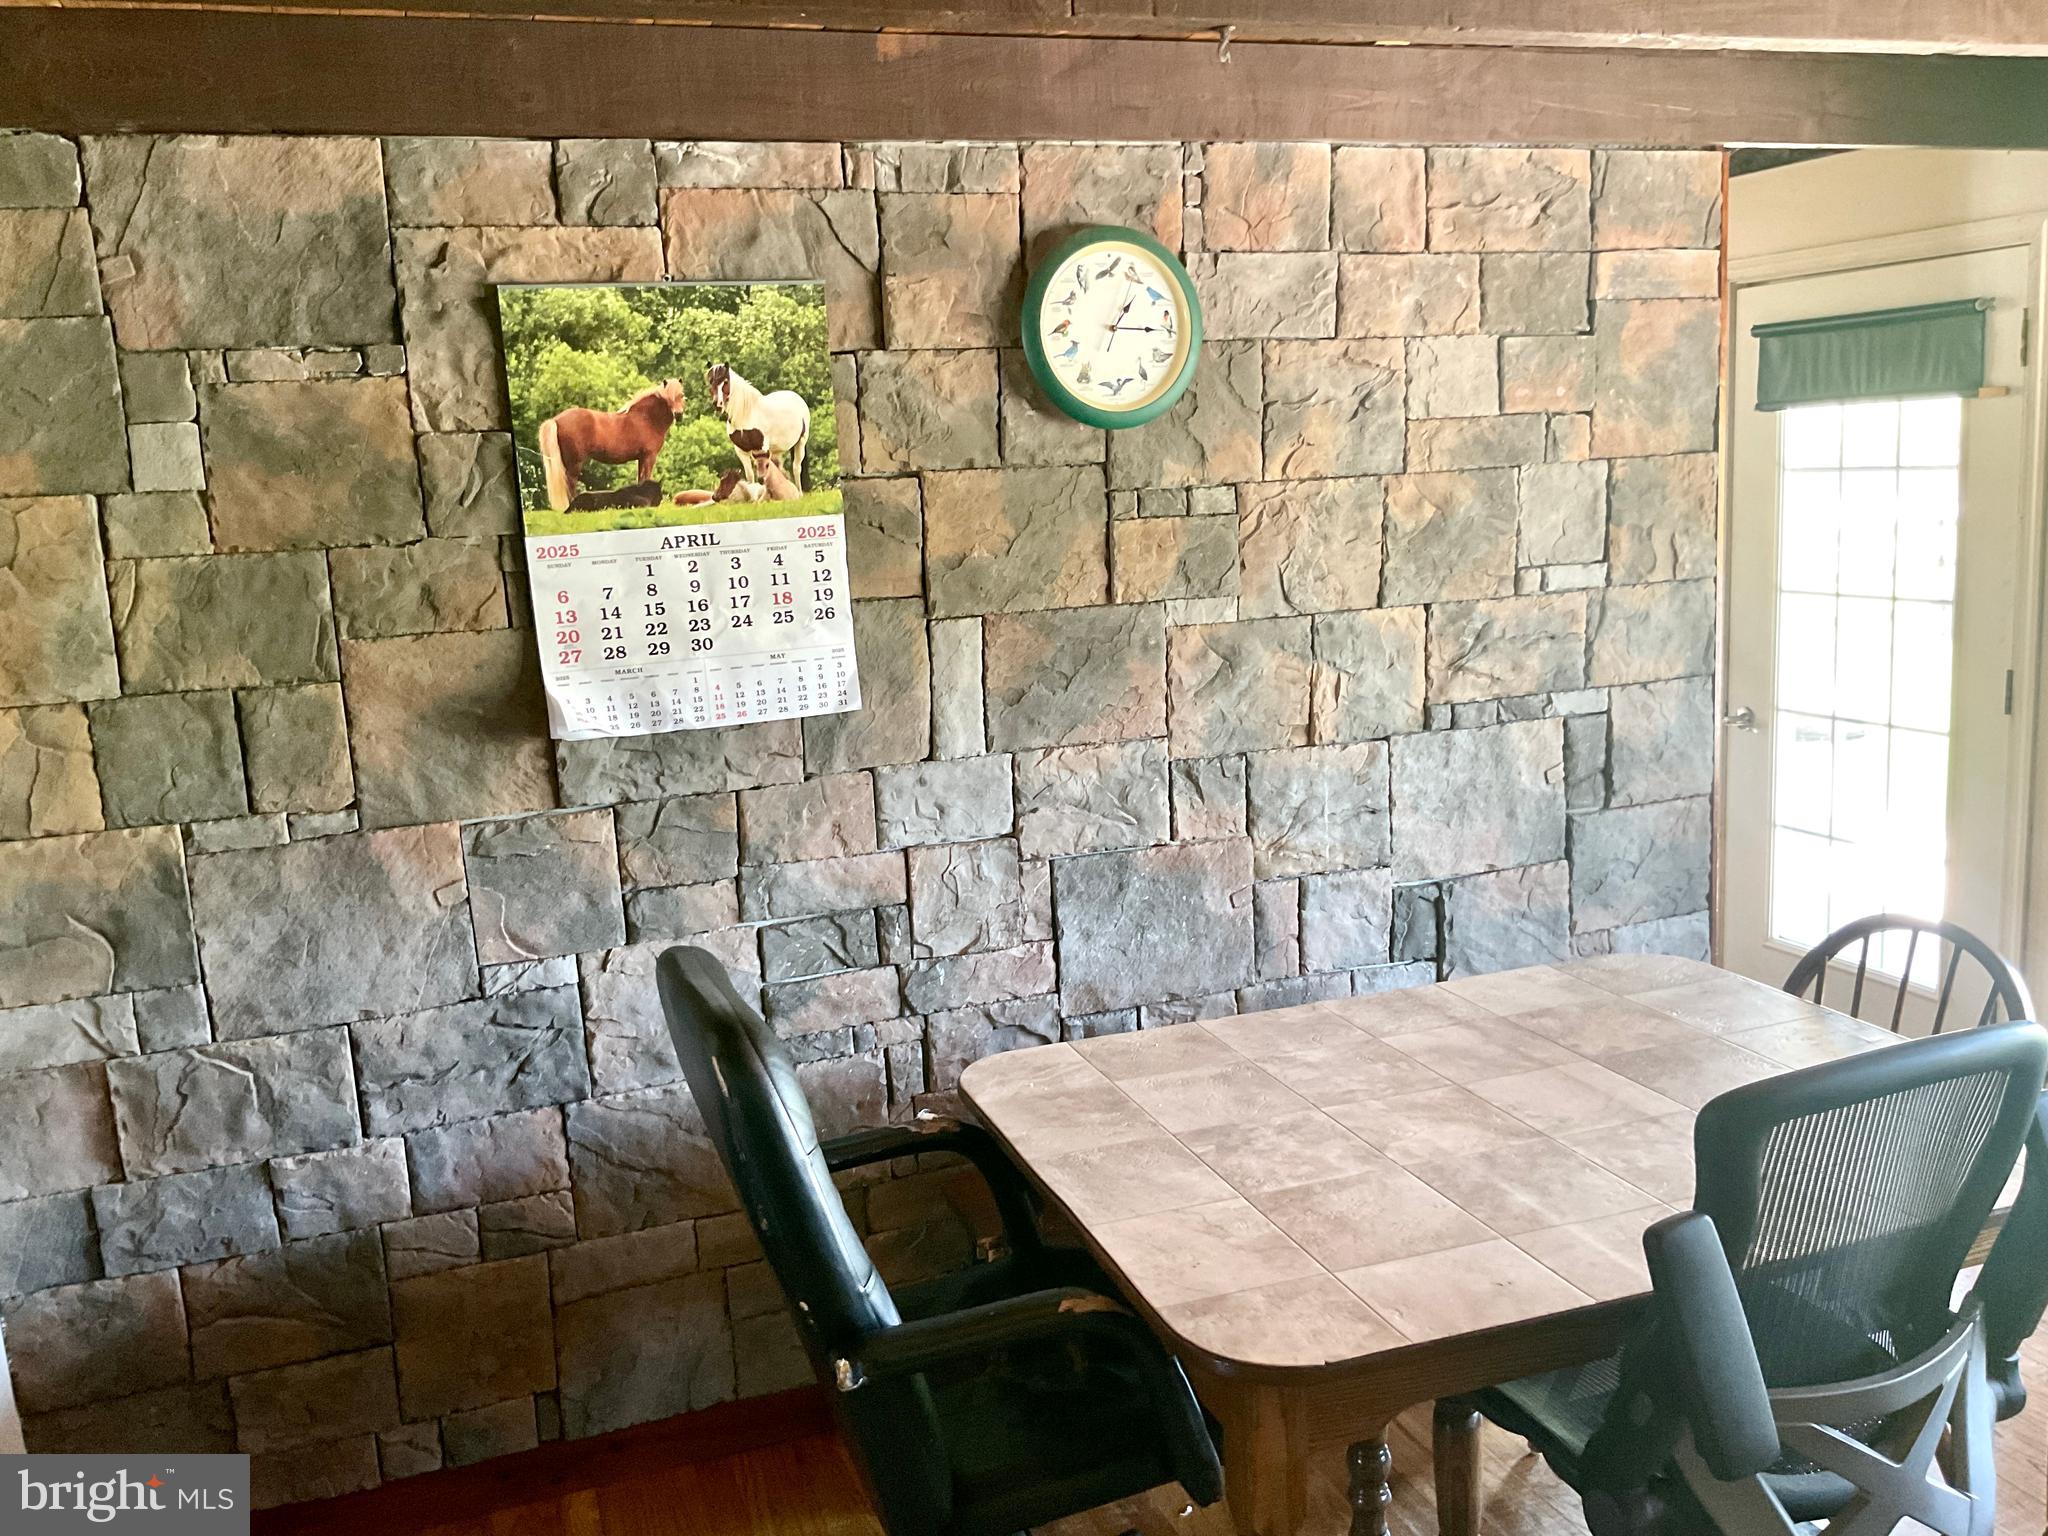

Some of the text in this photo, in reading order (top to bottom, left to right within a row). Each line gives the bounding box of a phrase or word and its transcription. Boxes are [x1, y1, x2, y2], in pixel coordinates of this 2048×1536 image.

[536, 525, 836, 559] 2025 APRIL 2025
[647, 550, 824, 576] 1 2 3 4 5
[558, 569, 831, 604] 6 7 8 9 10 11 12
[555, 588, 833, 624] 13 14 15 16 17 18 19
[557, 607, 835, 644] 20 21 22 23 24 25 26
[559, 638, 713, 664] 27 28 29 30
